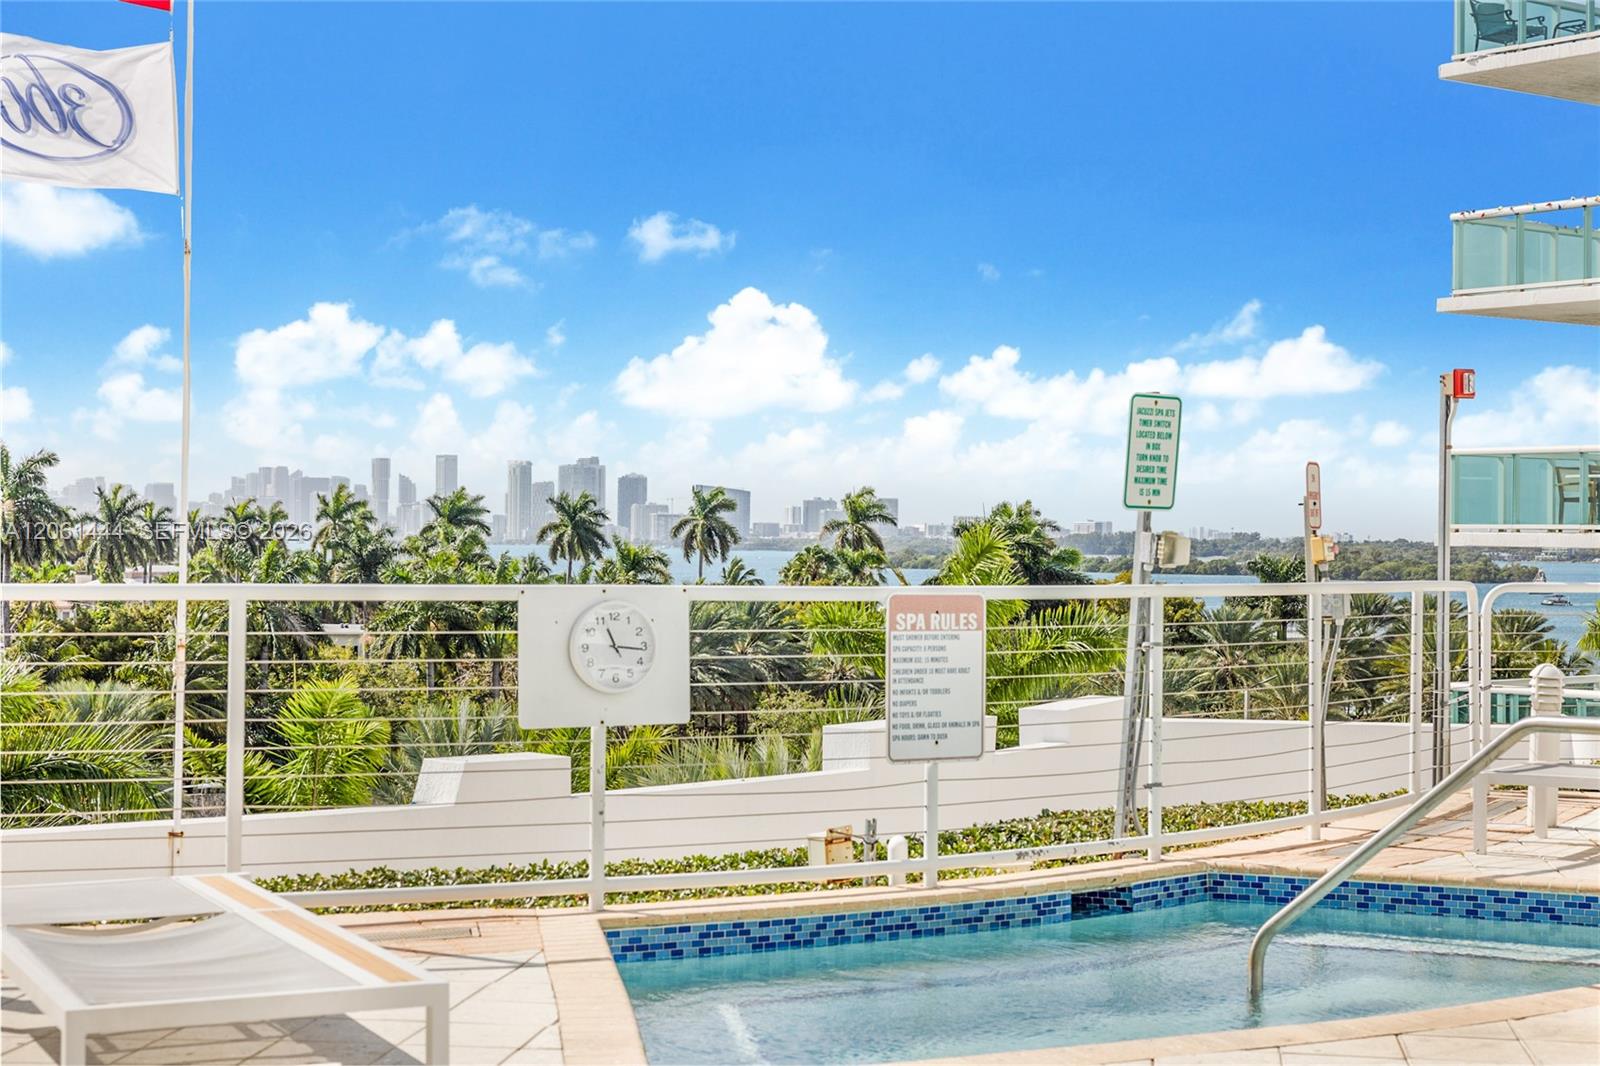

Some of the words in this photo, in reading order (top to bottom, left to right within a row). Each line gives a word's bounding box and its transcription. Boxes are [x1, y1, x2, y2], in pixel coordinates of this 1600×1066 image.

[1155, 408, 1164, 416] SPA
[1165, 409, 1176, 417] JETS
[1139, 418, 1152, 427] TIMER
[1154, 420, 1171, 428] SWITCH
[1136, 430, 1155, 439] LOCATED
[1156, 432, 1172, 440] BELOW
[1146, 442, 1151, 450] IN
[1152, 442, 1161, 450] BOX
[1136, 453, 1148, 461] TURN
[1149, 454, 1162, 462] KNOB
[1163, 455, 1169, 463] TO
[1136, 465, 1155, 473] DESIRED
[1156, 466, 1167, 474] TIME
[1157, 477, 1168, 486] TIME
[1139, 488, 1144, 496] IS
[1145, 488, 1151, 496] 15
[609, 612, 620, 621] 12
[896, 613, 926, 630] SPA
[931, 613, 977, 630] RULES
[586, 628, 596, 636] 10
[635, 627, 643, 636] 2
[581, 644, 589, 653] 9
[640, 642, 648, 651] 3
[587, 658, 594, 667] 8
[637, 657, 644, 665] 4
[598, 669, 605, 678] 7
[612, 673, 619, 683] 6
[627, 669, 634, 678] 5
